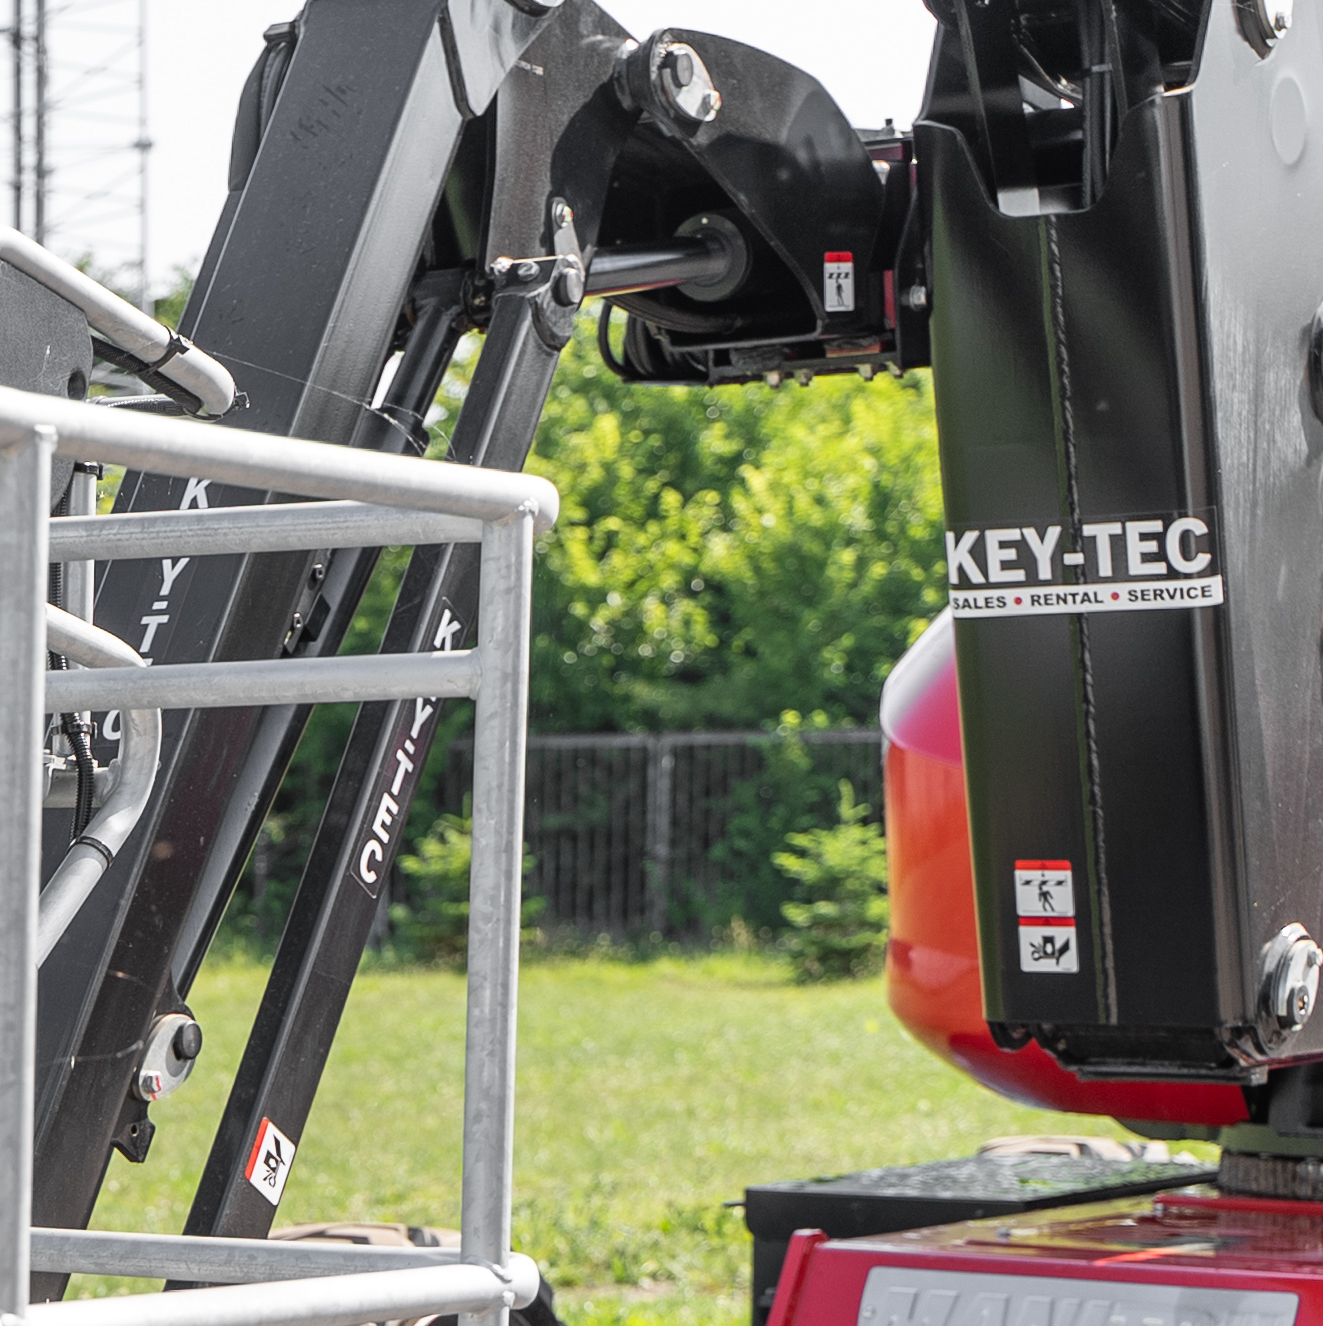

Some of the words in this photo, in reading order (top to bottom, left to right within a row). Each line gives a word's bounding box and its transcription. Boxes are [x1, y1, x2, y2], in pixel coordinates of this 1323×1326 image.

[103, 477, 212, 741] KY-T
[945, 517, 1212, 584] KEY-TEC
[953, 596, 1007, 611] SALES
[1030, 591, 1104, 607] RENTAL
[1128, 585, 1213, 602] SERVICE
[360, 608, 461, 884] KY-TEC
